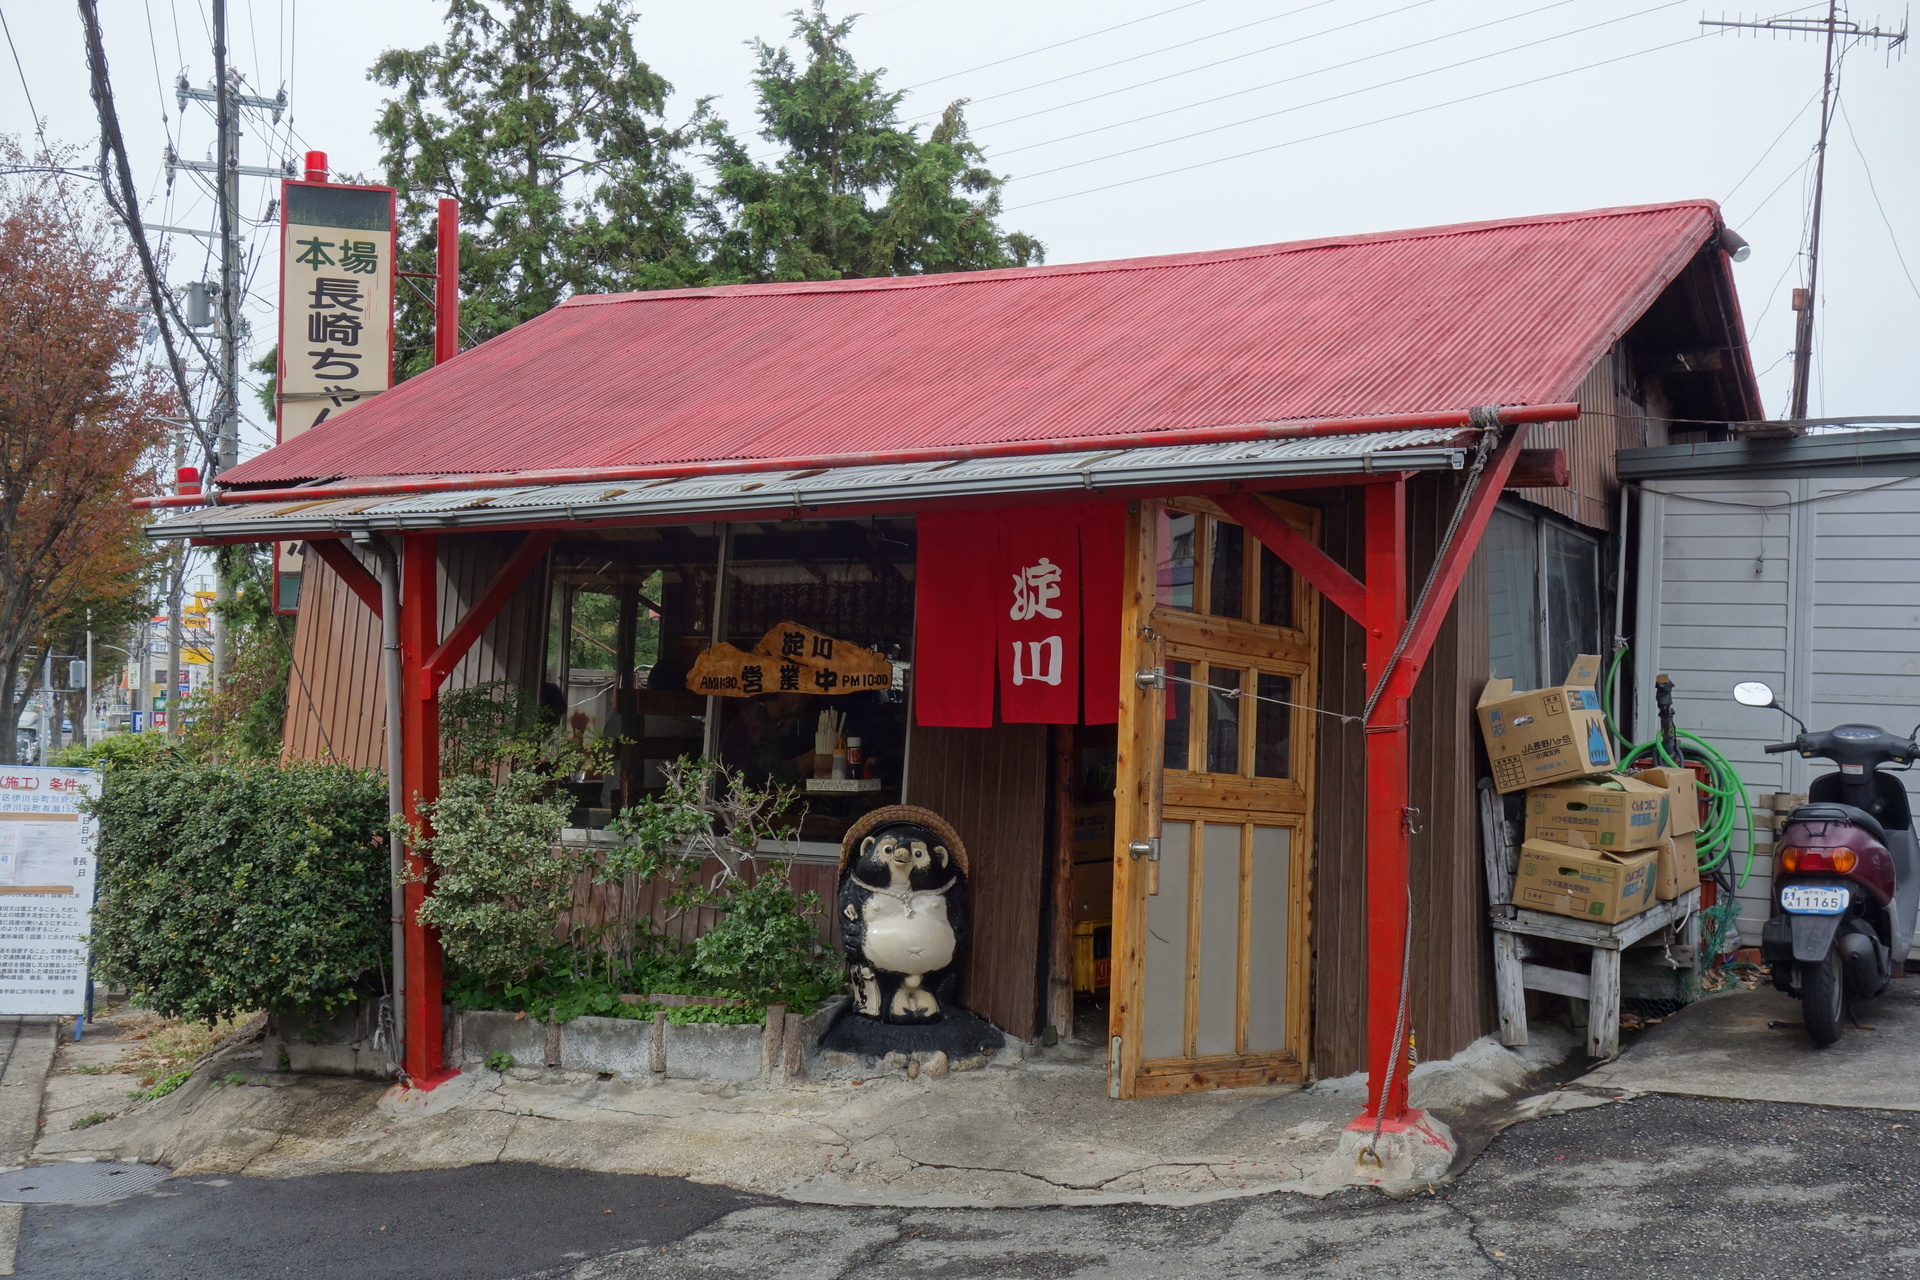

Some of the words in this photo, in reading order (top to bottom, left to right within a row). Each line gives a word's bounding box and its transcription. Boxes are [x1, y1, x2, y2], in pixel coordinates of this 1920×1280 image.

[295, 236, 379, 275] 本場
[1009, 557, 1063, 686] 淀川
[782, 631, 833, 660] 淀川
[741, 665, 838, 693] 営業中
[842, 675, 860, 687] PM
[862, 674, 889, 687] 10:00
[1551, 705, 1558, 713] L
[1796, 896, 1839, 908] 11165
